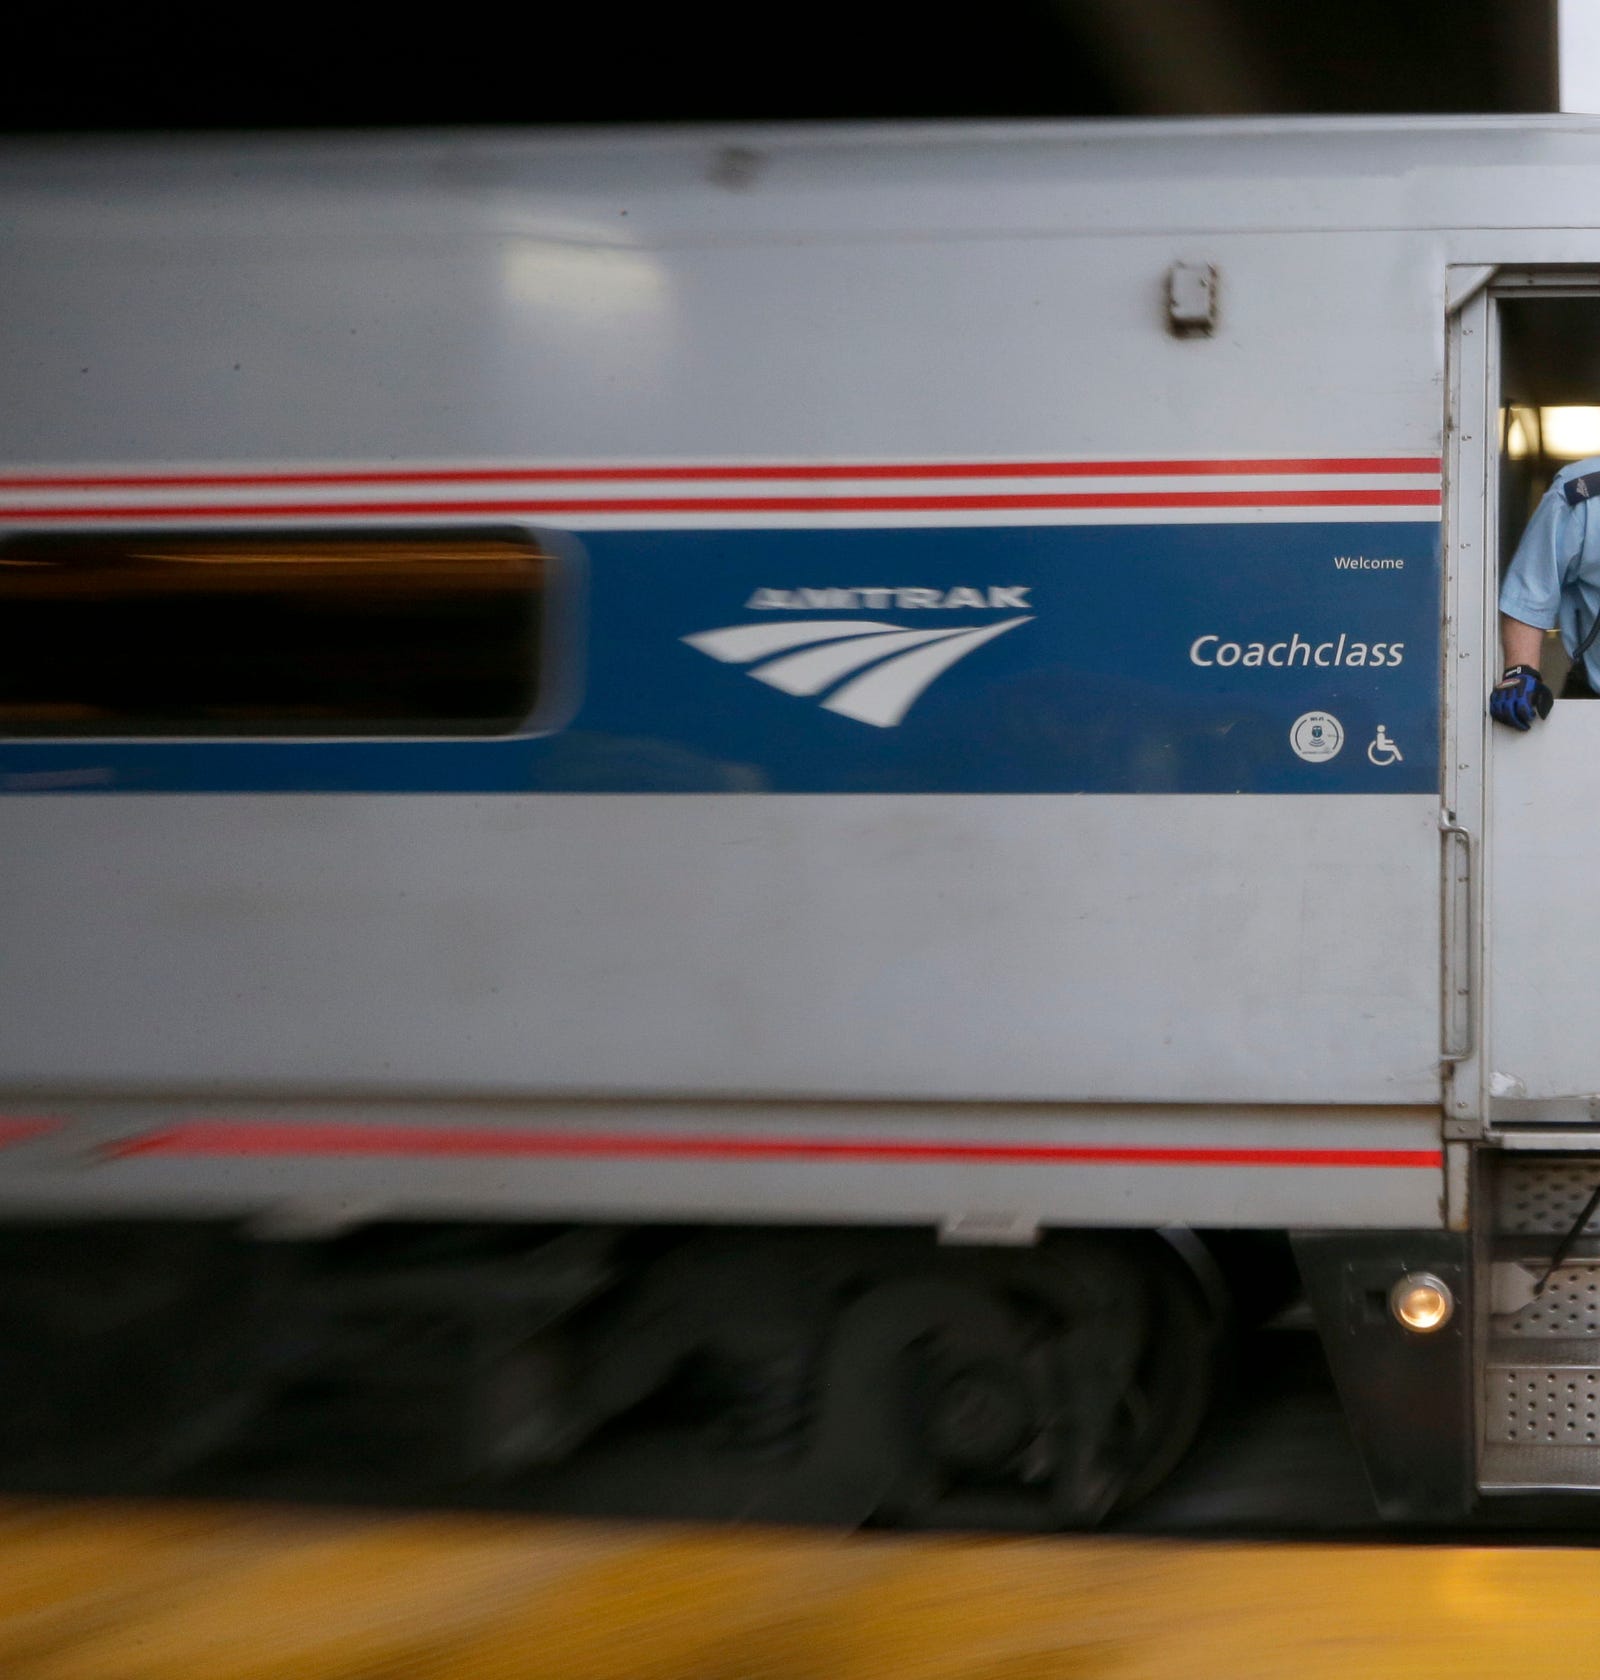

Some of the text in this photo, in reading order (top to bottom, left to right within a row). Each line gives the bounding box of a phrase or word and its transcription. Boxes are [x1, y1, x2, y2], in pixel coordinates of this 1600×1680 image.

[1333, 556, 1404, 570] Welcome
[745, 586, 1032, 609] AMTRAK
[1189, 633, 1404, 667] Coachclass
